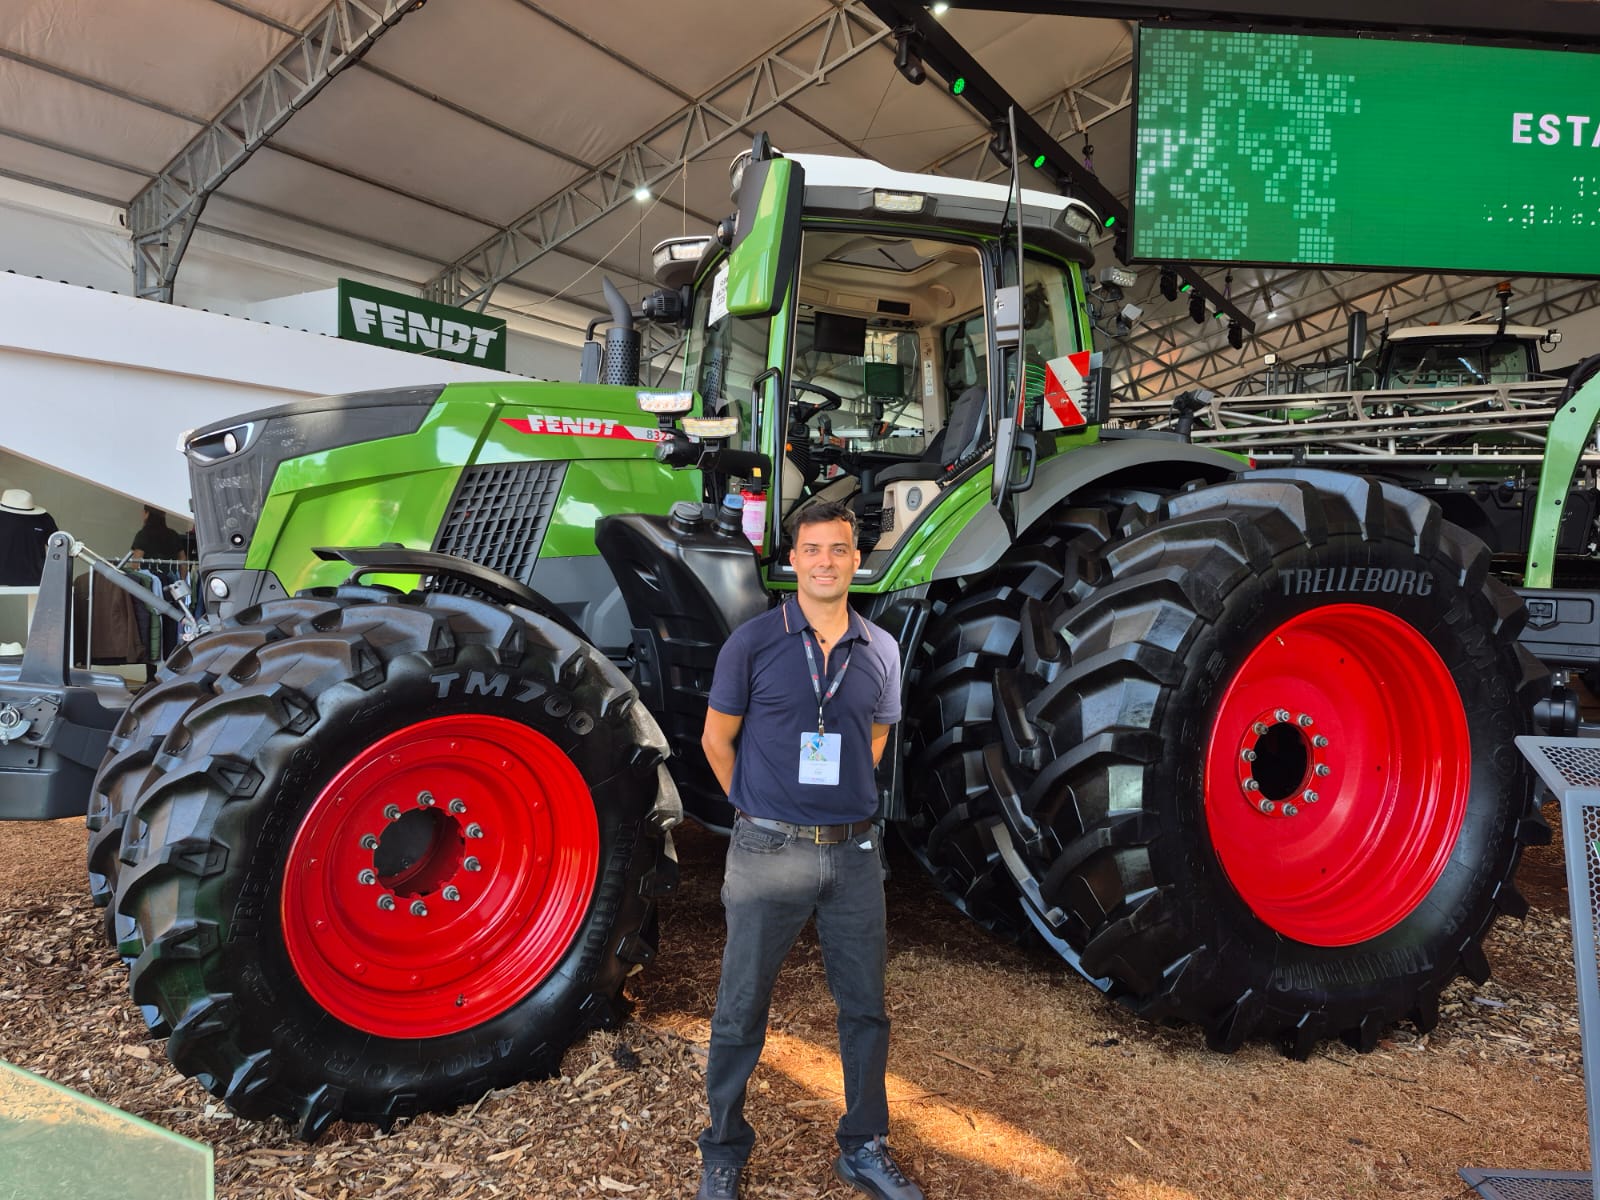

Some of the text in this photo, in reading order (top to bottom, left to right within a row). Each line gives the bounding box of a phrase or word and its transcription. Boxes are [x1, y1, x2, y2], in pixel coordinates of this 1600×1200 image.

[349, 297, 498, 360] FENDT
[527, 414, 619, 436] FENDT
[1278, 566, 1434, 598] TRELLEBORG
